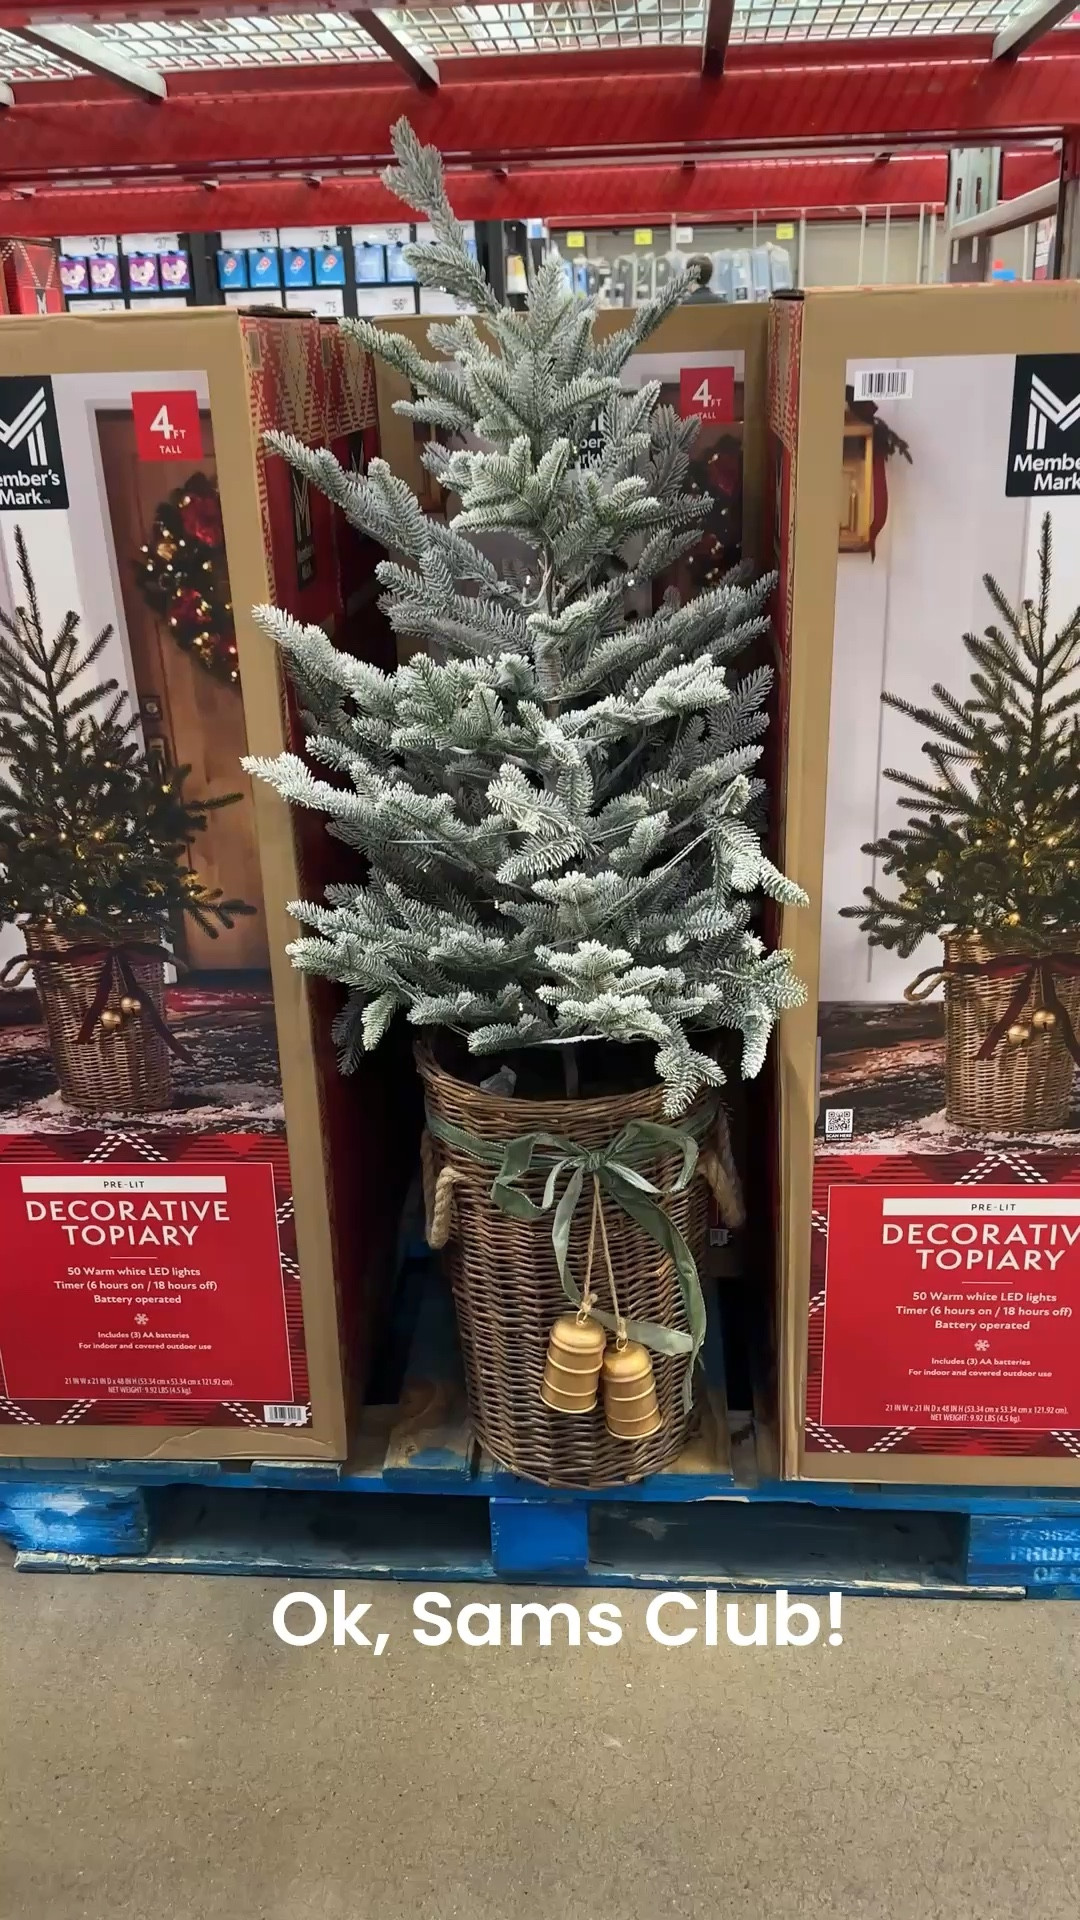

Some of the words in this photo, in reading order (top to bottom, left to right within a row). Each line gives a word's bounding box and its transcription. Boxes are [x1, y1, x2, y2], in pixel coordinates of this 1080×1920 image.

[692, 379, 712, 407] 4
[711, 399, 722, 407] FT
[150, 405, 174, 440] 4
[173, 430, 186, 439] FT
[160, 445, 182, 454] TALL
[1013, 453, 1080, 472] Memb
[0, 469, 60, 487] mber's
[1033, 472, 1080, 491] Mark
[104, 1180, 145, 1189] PRE-LIT
[25, 1201, 230, 1221] DECORATIVE
[972, 1203, 1016, 1212] PRE-LIT
[61, 1225, 199, 1245] TOPIARY
[882, 1224, 1080, 1245] DECORATIV
[915, 1249, 1066, 1270] TOPIARY
[67, 1267, 82, 1275] 50
[82, 1267, 115, 1275] Warm
[116, 1267, 147, 1275] white
[148, 1267, 170, 1275] LED
[171, 1268, 201, 1278] lights
[53, 1281, 85, 1289] Timer
[86, 1281, 98, 1290] (6
[99, 1281, 129, 1289] hours
[153, 1281, 166, 1289] 18
[167, 1281, 198, 1289] hours
[198, 1281, 218, 1291] off)
[93, 1295, 133, 1305] Battery
[134, 1295, 182, 1305] operated
[912, 1292, 928, 1300] 50
[929, 1292, 964, 1300] Warm
[965, 1292, 998, 1300] white
[1000, 1293, 1024, 1301] LED
[1025, 1293, 1057, 1304] lights
[895, 1306, 929, 1314] Timer
[929, 1306, 942, 1316] (6
[943, 1306, 976, 1315] hours
[1002, 1307, 1016, 1315] 18
[1017, 1307, 1050, 1315] hours
[1051, 1307, 1073, 1317] off)
[934, 1320, 978, 1331] Battery
[979, 1321, 1031, 1331] operated
[98, 1331, 129, 1339] Includes
[131, 1331, 141, 1339] (3)
[143, 1331, 154, 1339] AA
[156, 1331, 189, 1339] batteries
[119, 1342, 133, 1350] and
[135, 1342, 164, 1350] covered
[167, 1342, 196, 1350] outdoor
[932, 1357, 965, 1365] Includes
[967, 1357, 978, 1366] (3)
[994, 1357, 1030, 1366] batteries
[909, 1368, 922, 1376] For
[924, 1368, 950, 1376] indoor
[952, 1368, 967, 1376] and
[969, 1369, 1001, 1377] covered
[1003, 1369, 1036, 1377] outdoor
[964, 1406, 983, 1414] (53.34
[1000, 1406, 1017, 1414] 53.34
[1034, 1406, 1054, 1414] 121.92
[1055, 1407, 1068, 1415] cm).
[970, 1414, 983, 1422] 9.92
[984, 1414, 995, 1422] LBS
[997, 1415, 1009, 1423] (4.5
[1010, 1415, 1021, 1423] kg).
